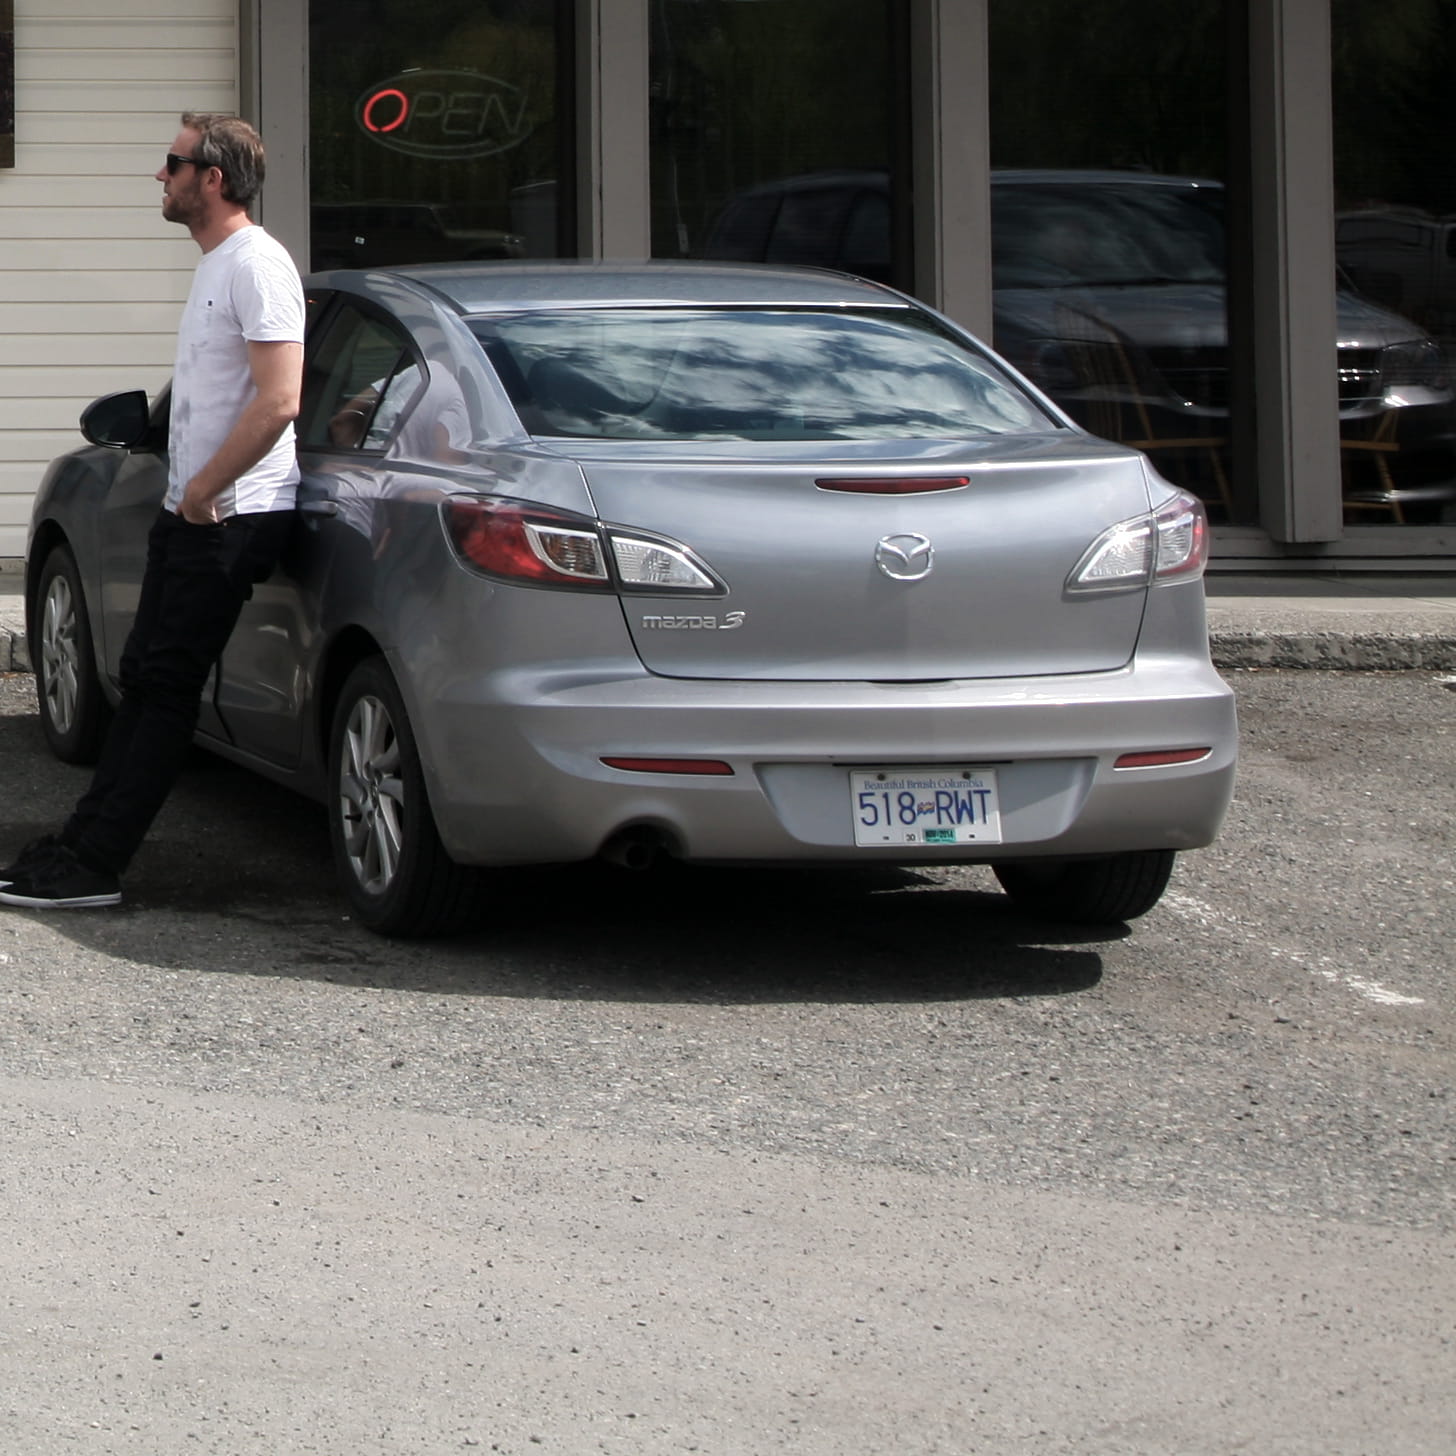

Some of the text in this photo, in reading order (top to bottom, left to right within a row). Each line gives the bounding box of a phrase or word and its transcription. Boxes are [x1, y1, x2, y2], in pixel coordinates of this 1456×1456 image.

[363, 88, 529, 134] OPEN
[864, 777, 983, 790] Beautiful British Columbia
